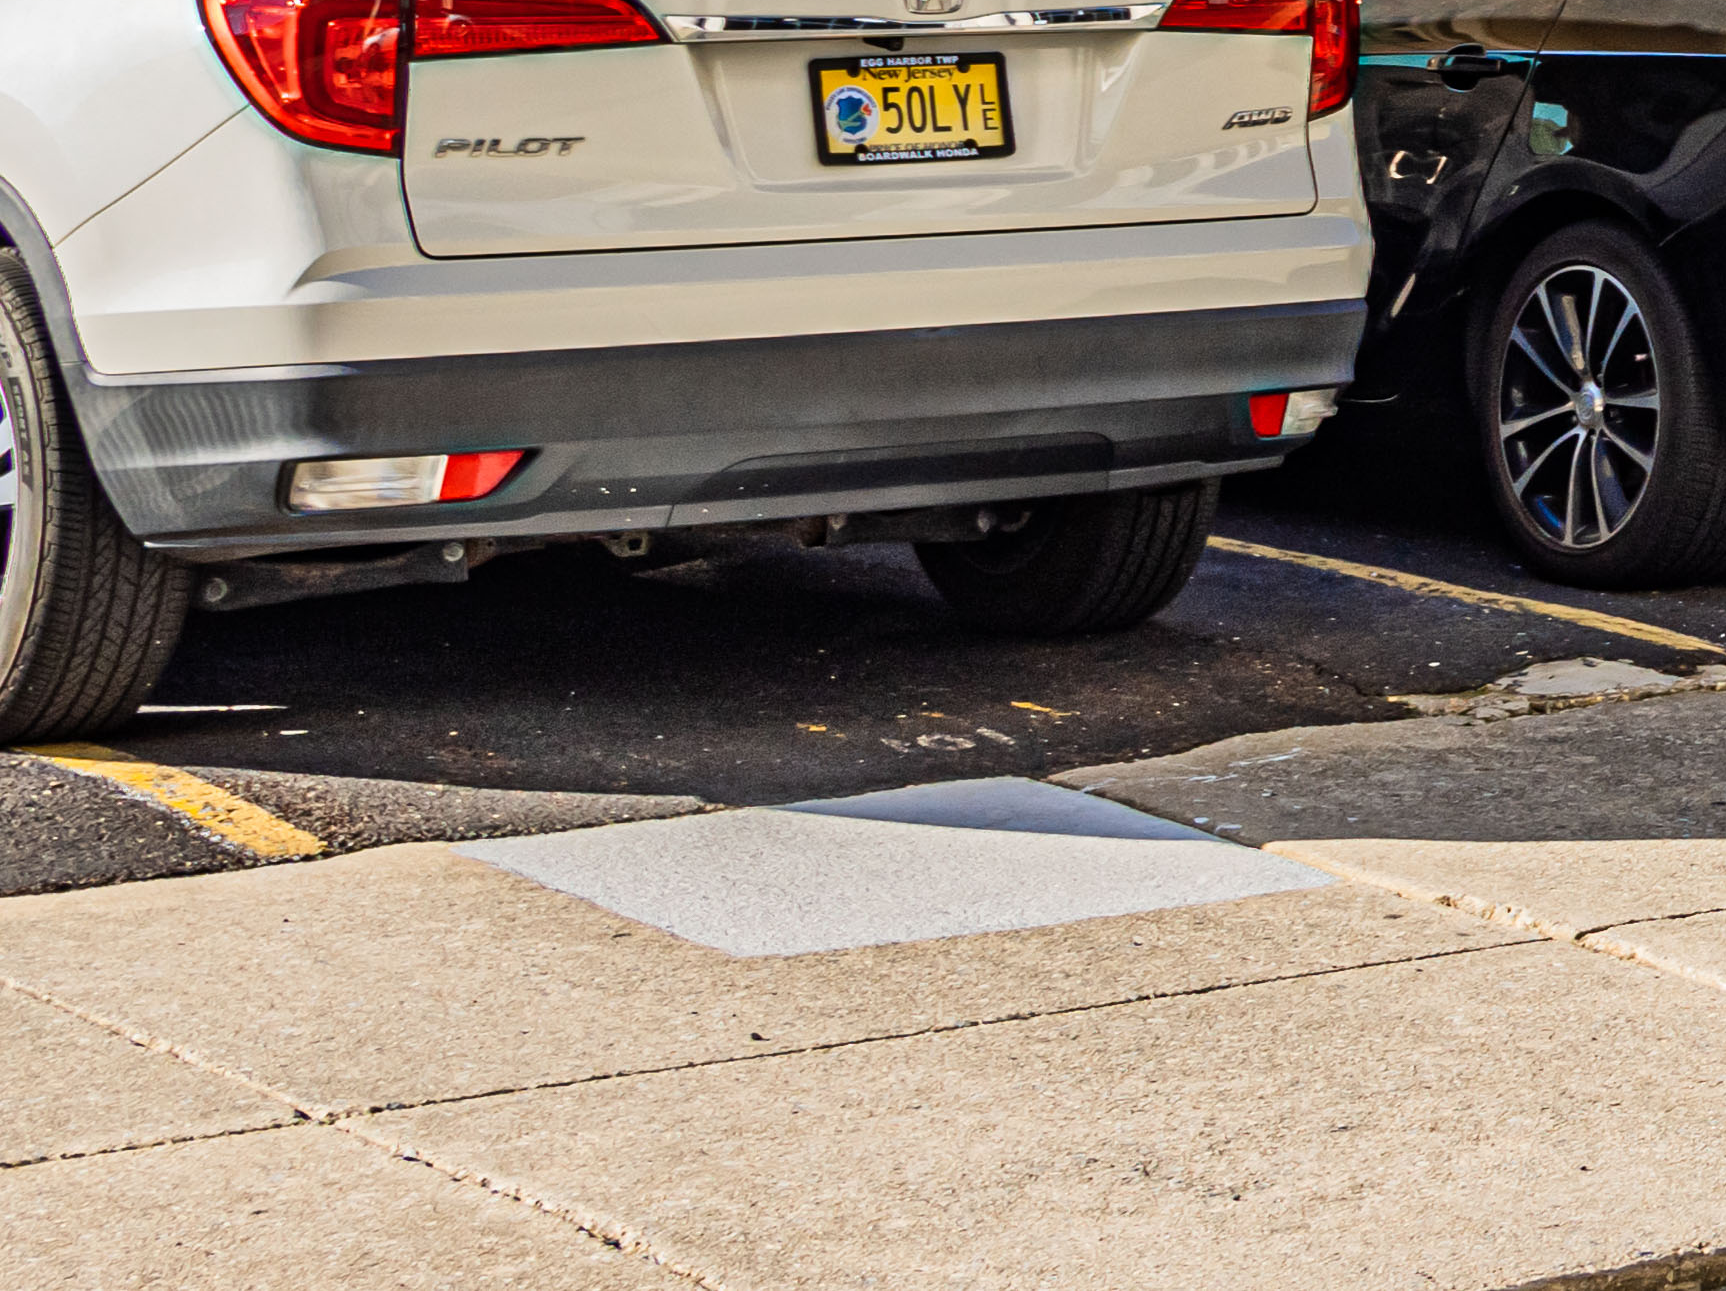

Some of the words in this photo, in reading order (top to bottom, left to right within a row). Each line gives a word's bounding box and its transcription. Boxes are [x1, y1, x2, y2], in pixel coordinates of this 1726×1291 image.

[860, 58, 884, 68] EGG
[888, 56, 933, 67] HARBOR
[936, 55, 959, 64] TWP
[862, 67, 902, 81] New
[905, 66, 956, 83] Jersey
[1222, 106, 1293, 130] AWD
[435, 137, 585, 158] PILOT
[857, 150, 933, 162] BOARDWALK
[936, 147, 979, 158] HONDA
